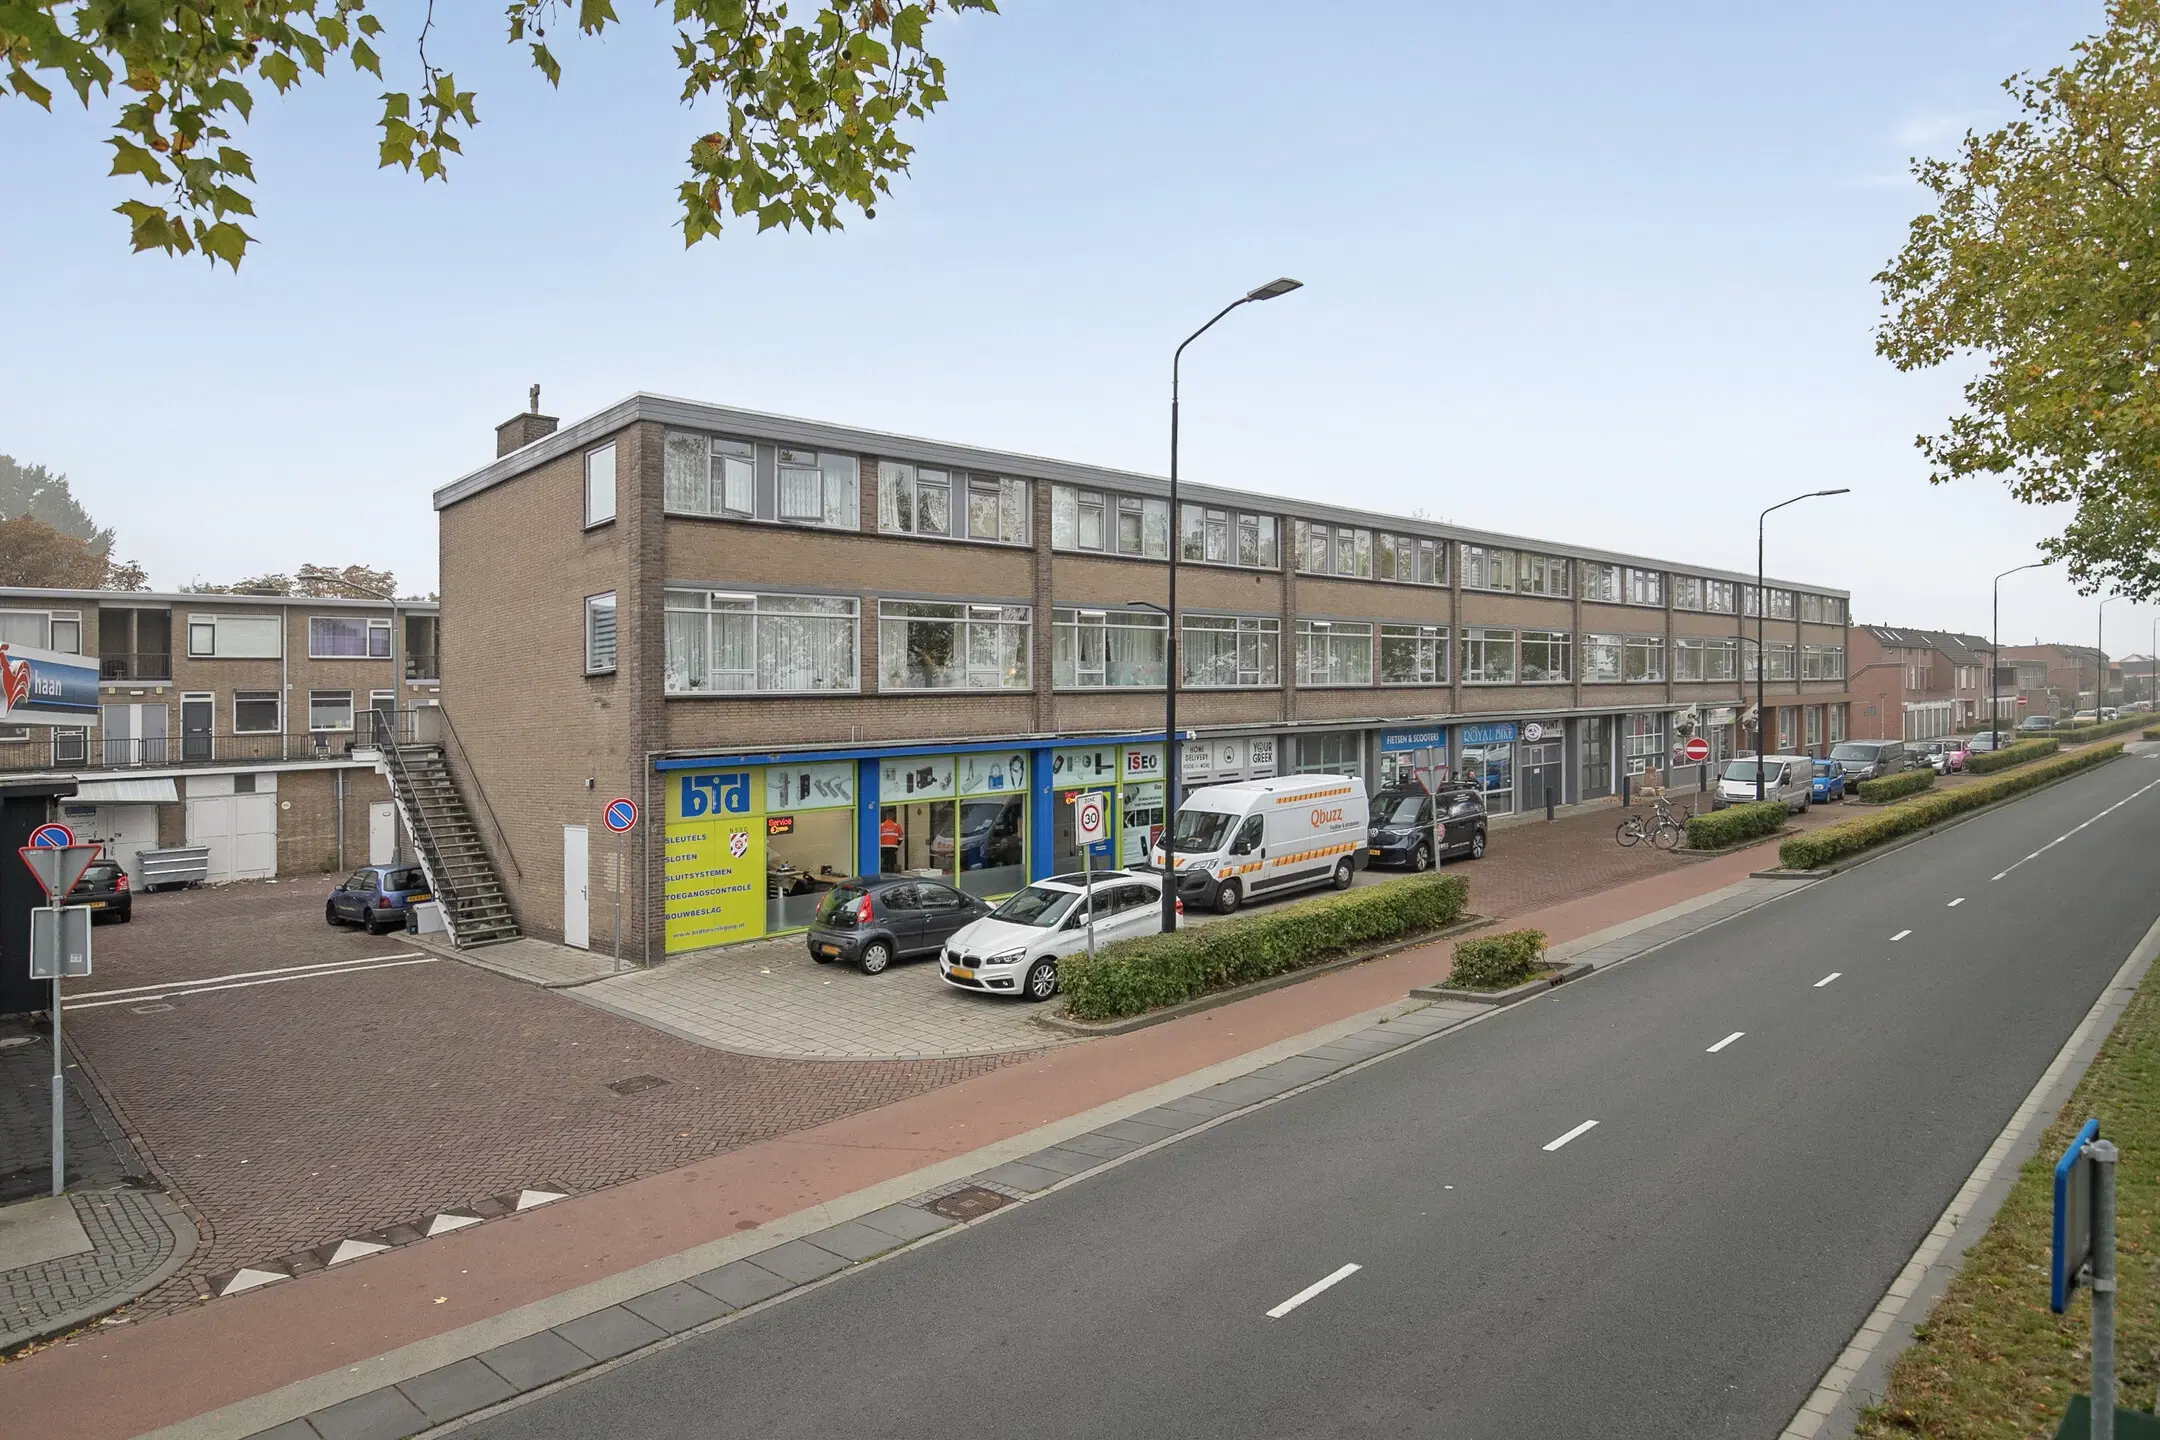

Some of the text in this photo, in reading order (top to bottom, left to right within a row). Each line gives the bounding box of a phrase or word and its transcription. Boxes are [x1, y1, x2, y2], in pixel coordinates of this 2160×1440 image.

[34, 669, 62, 697] haan
[1386, 735, 1408, 745] FIETSEN
[1413, 732, 1440, 743] SCOOTERS
[1463, 729, 1494, 743] ROYAL
[1495, 727, 1513, 740] BIKE
[1190, 745, 1204, 753] HOME
[1253, 741, 1273, 753] YOUR
[1127, 754, 1158, 770] ISEO
[1185, 753, 1208, 762] DELIVERY
[1252, 752, 1273, 764] GREEK
[1084, 796, 1096, 804] ZONE
[768, 818, 792, 826] Service
[1084, 812, 1097, 825] 30
[1311, 808, 1343, 828] Qbuzz
[664, 833, 707, 844] SLEUTELS
[664, 853, 698, 863] SLOTEN
[664, 867, 732, 882] SLUITSYSTEMEN
[665, 883, 752, 901] TOEGANGSCONTROLE
[664, 906, 722, 920] BOUWBESLAG
